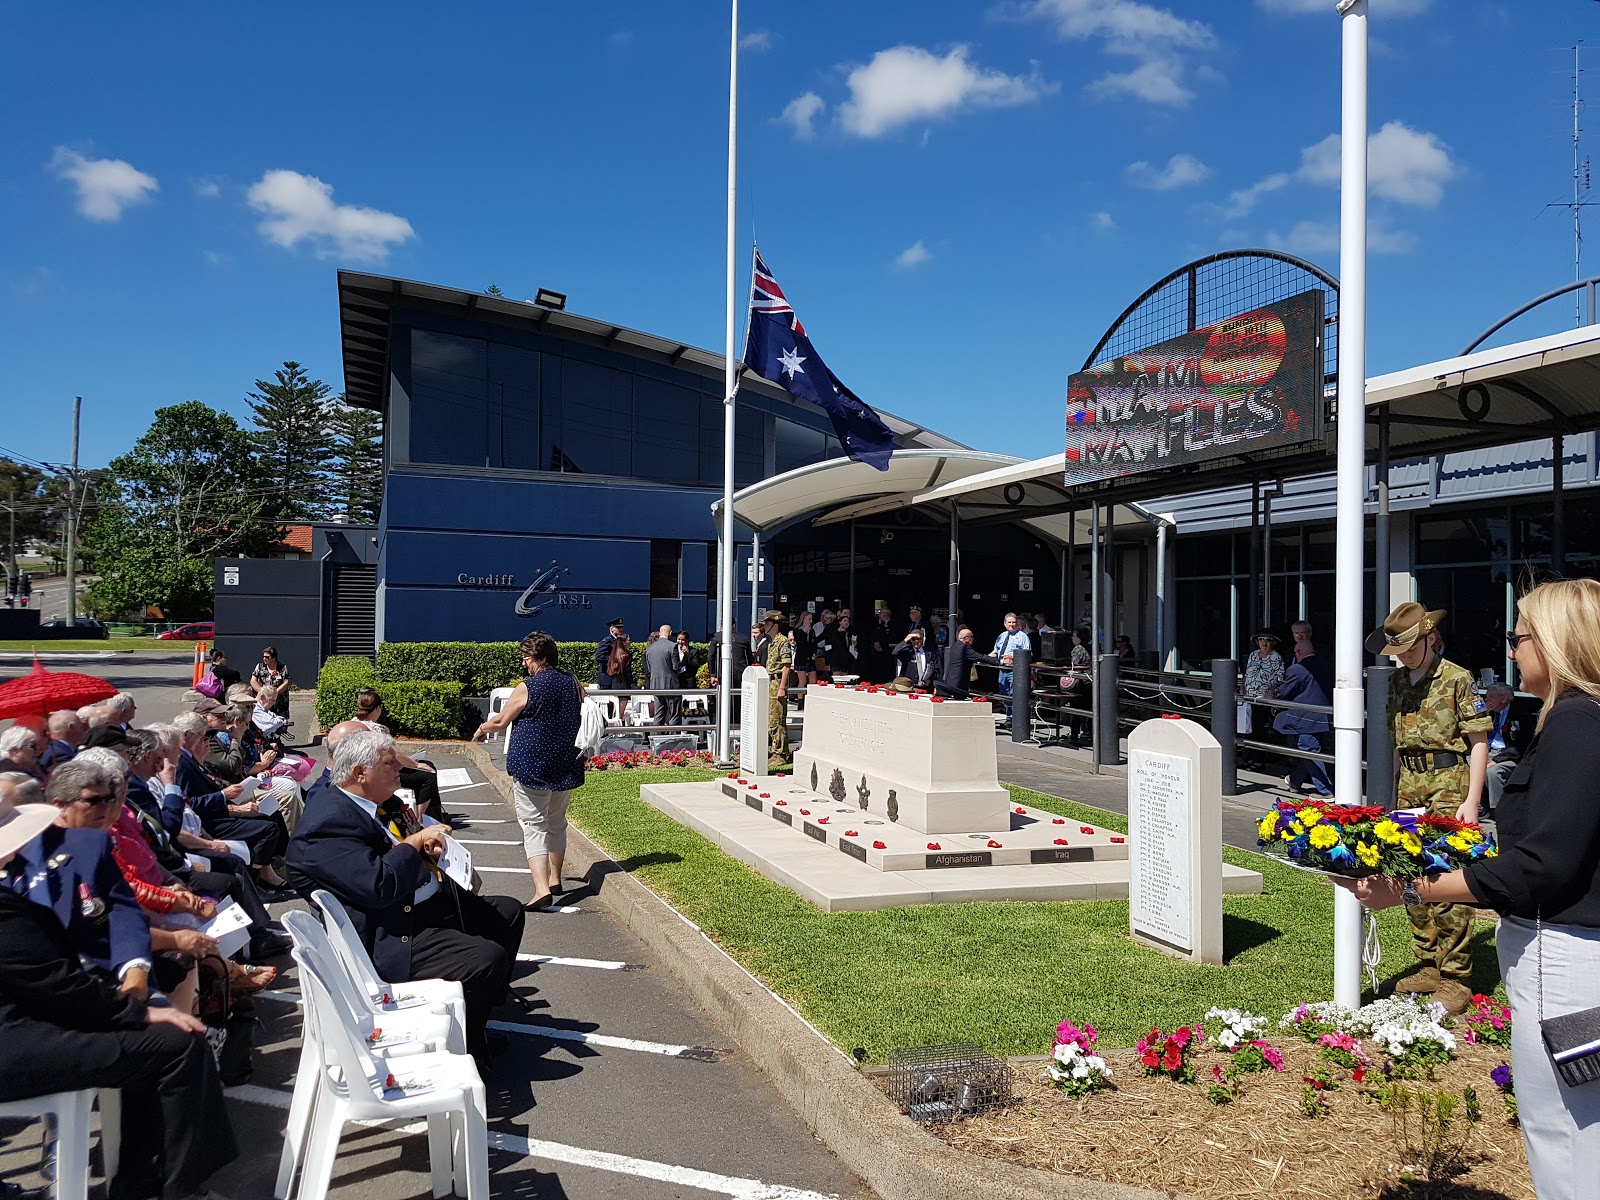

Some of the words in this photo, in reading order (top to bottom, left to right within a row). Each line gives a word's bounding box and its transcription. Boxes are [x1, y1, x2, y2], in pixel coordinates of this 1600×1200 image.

[457, 572, 514, 586] Cardiff
[558, 594, 590, 605] RSL
[1145, 760, 1170, 770] CARDIFF
[936, 854, 982, 866] Afghanistan
[1055, 850, 1070, 860] Iraq
